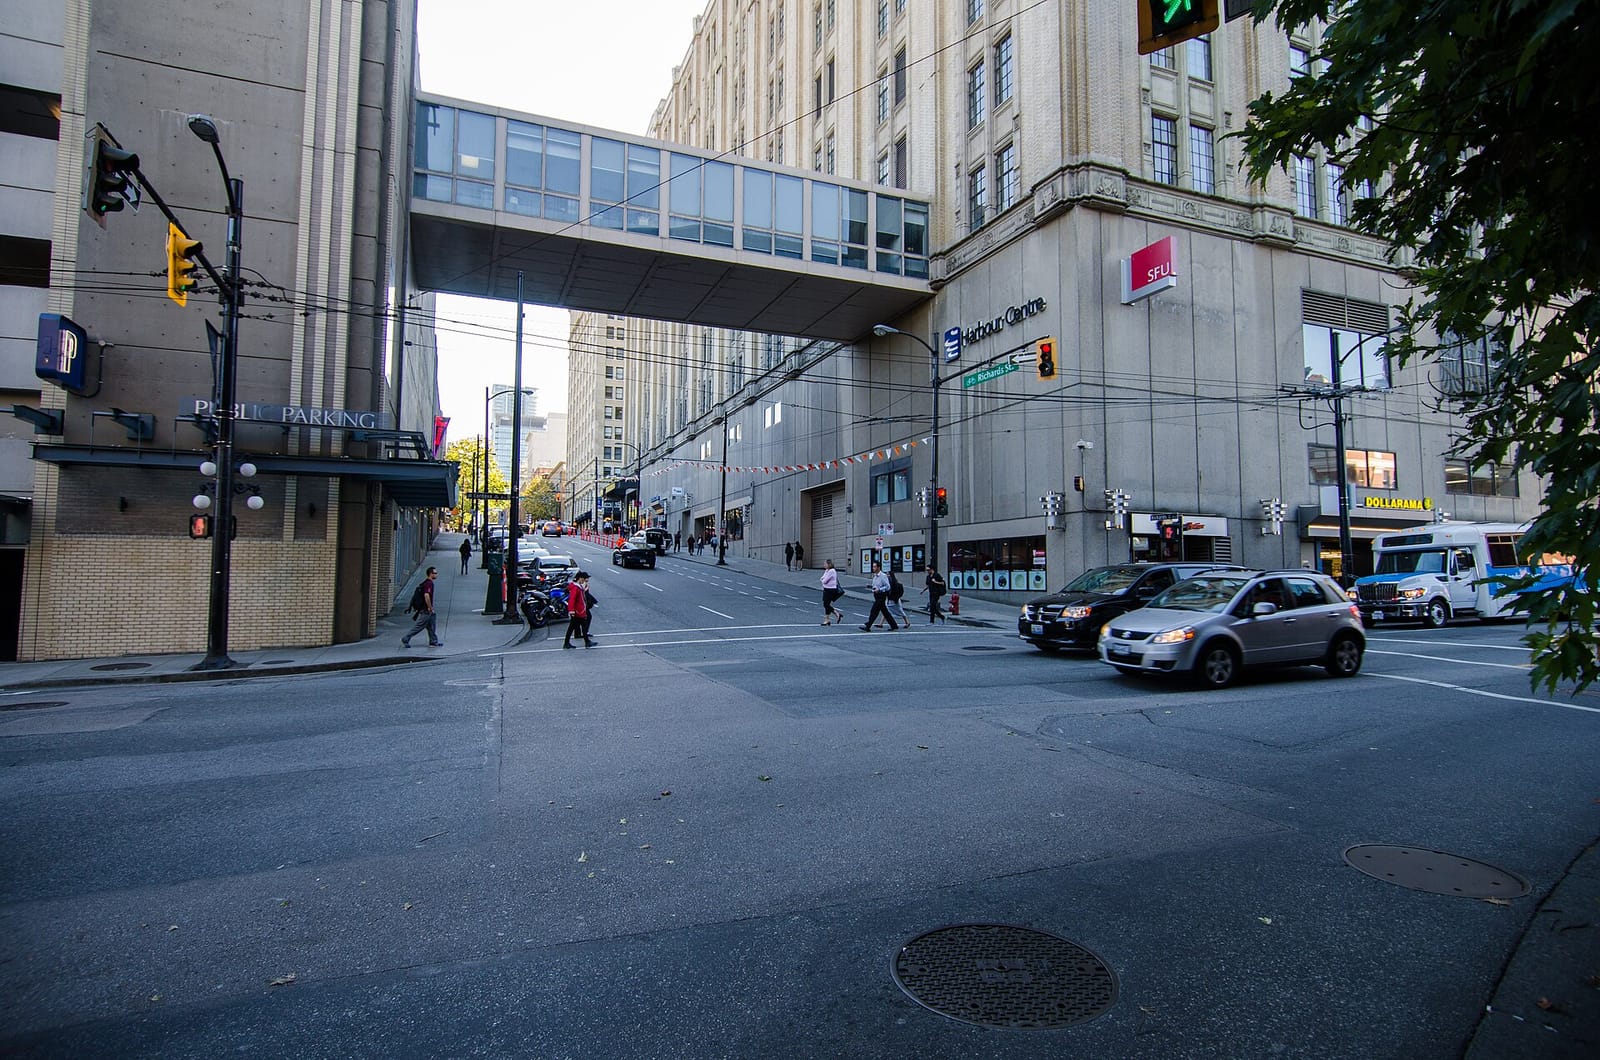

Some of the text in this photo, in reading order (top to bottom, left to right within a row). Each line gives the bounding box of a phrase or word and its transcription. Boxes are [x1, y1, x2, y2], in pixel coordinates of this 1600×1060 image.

[1147, 261, 1170, 282] SFU
[961, 296, 1047, 347] Harbour Centre
[60, 329, 77, 373] P
[977, 365, 1004, 382] Richards
[282, 407, 376, 429] PARKING
[1365, 496, 1423, 509] DOLLARAMA
